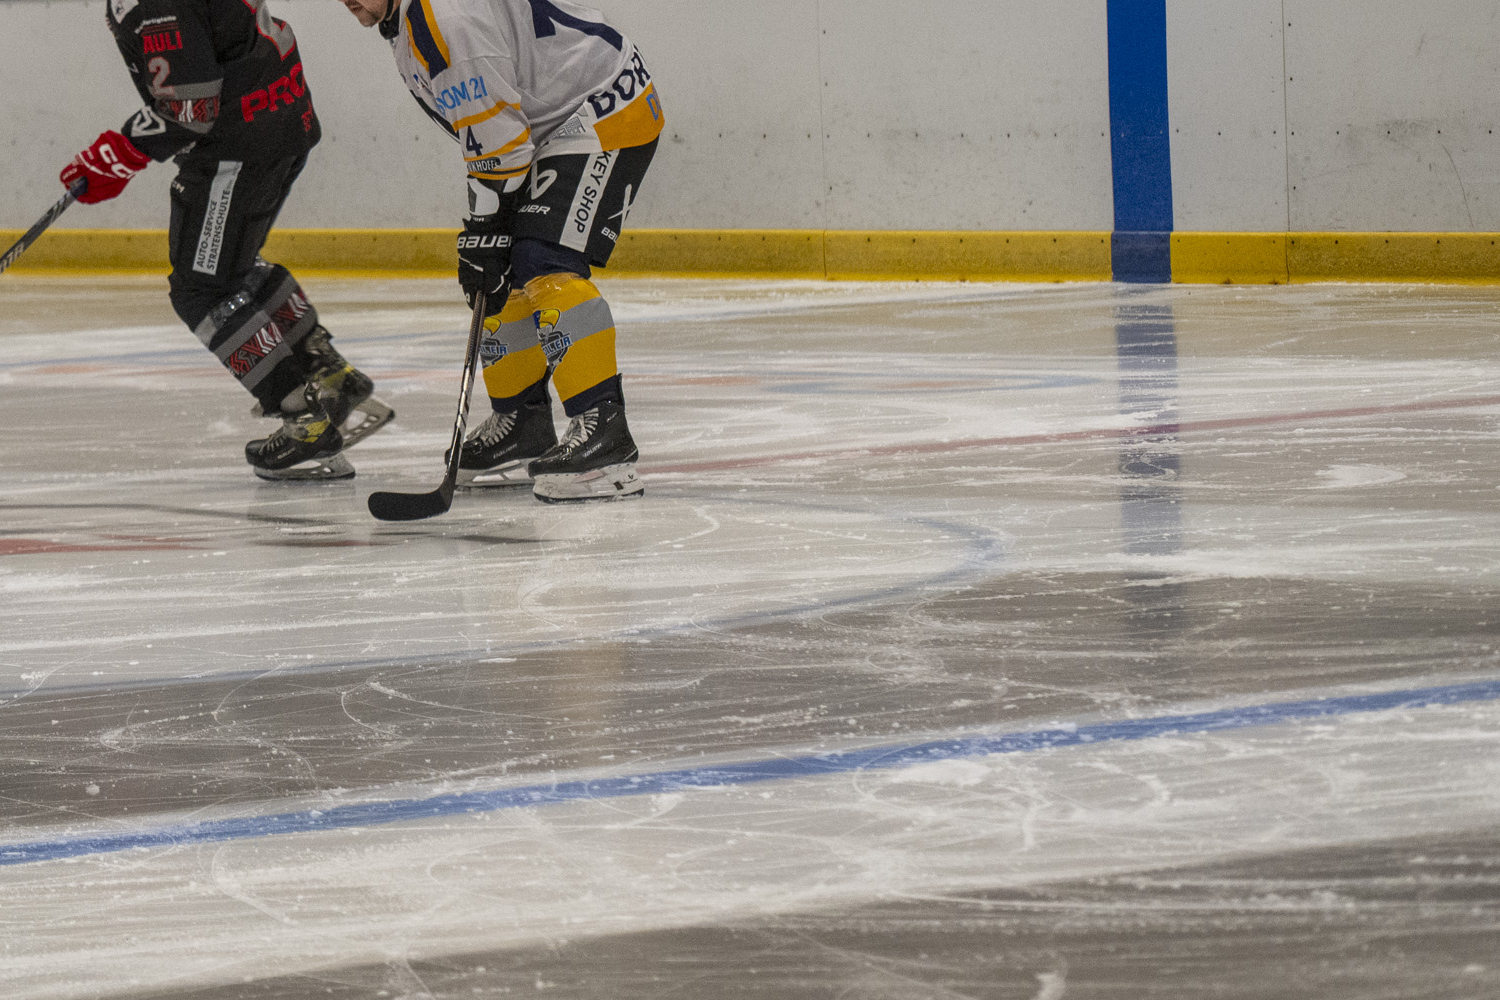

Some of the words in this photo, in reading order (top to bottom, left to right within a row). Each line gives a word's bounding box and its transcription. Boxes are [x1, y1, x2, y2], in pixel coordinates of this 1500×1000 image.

[587, 43, 652, 119] DOR
[592, 150, 613, 187] KEY
[196, 200, 218, 268] AUTO-SERVICE
[206, 189, 231, 271] STRATENSCHULTE
[573, 185, 598, 234] SHOP
